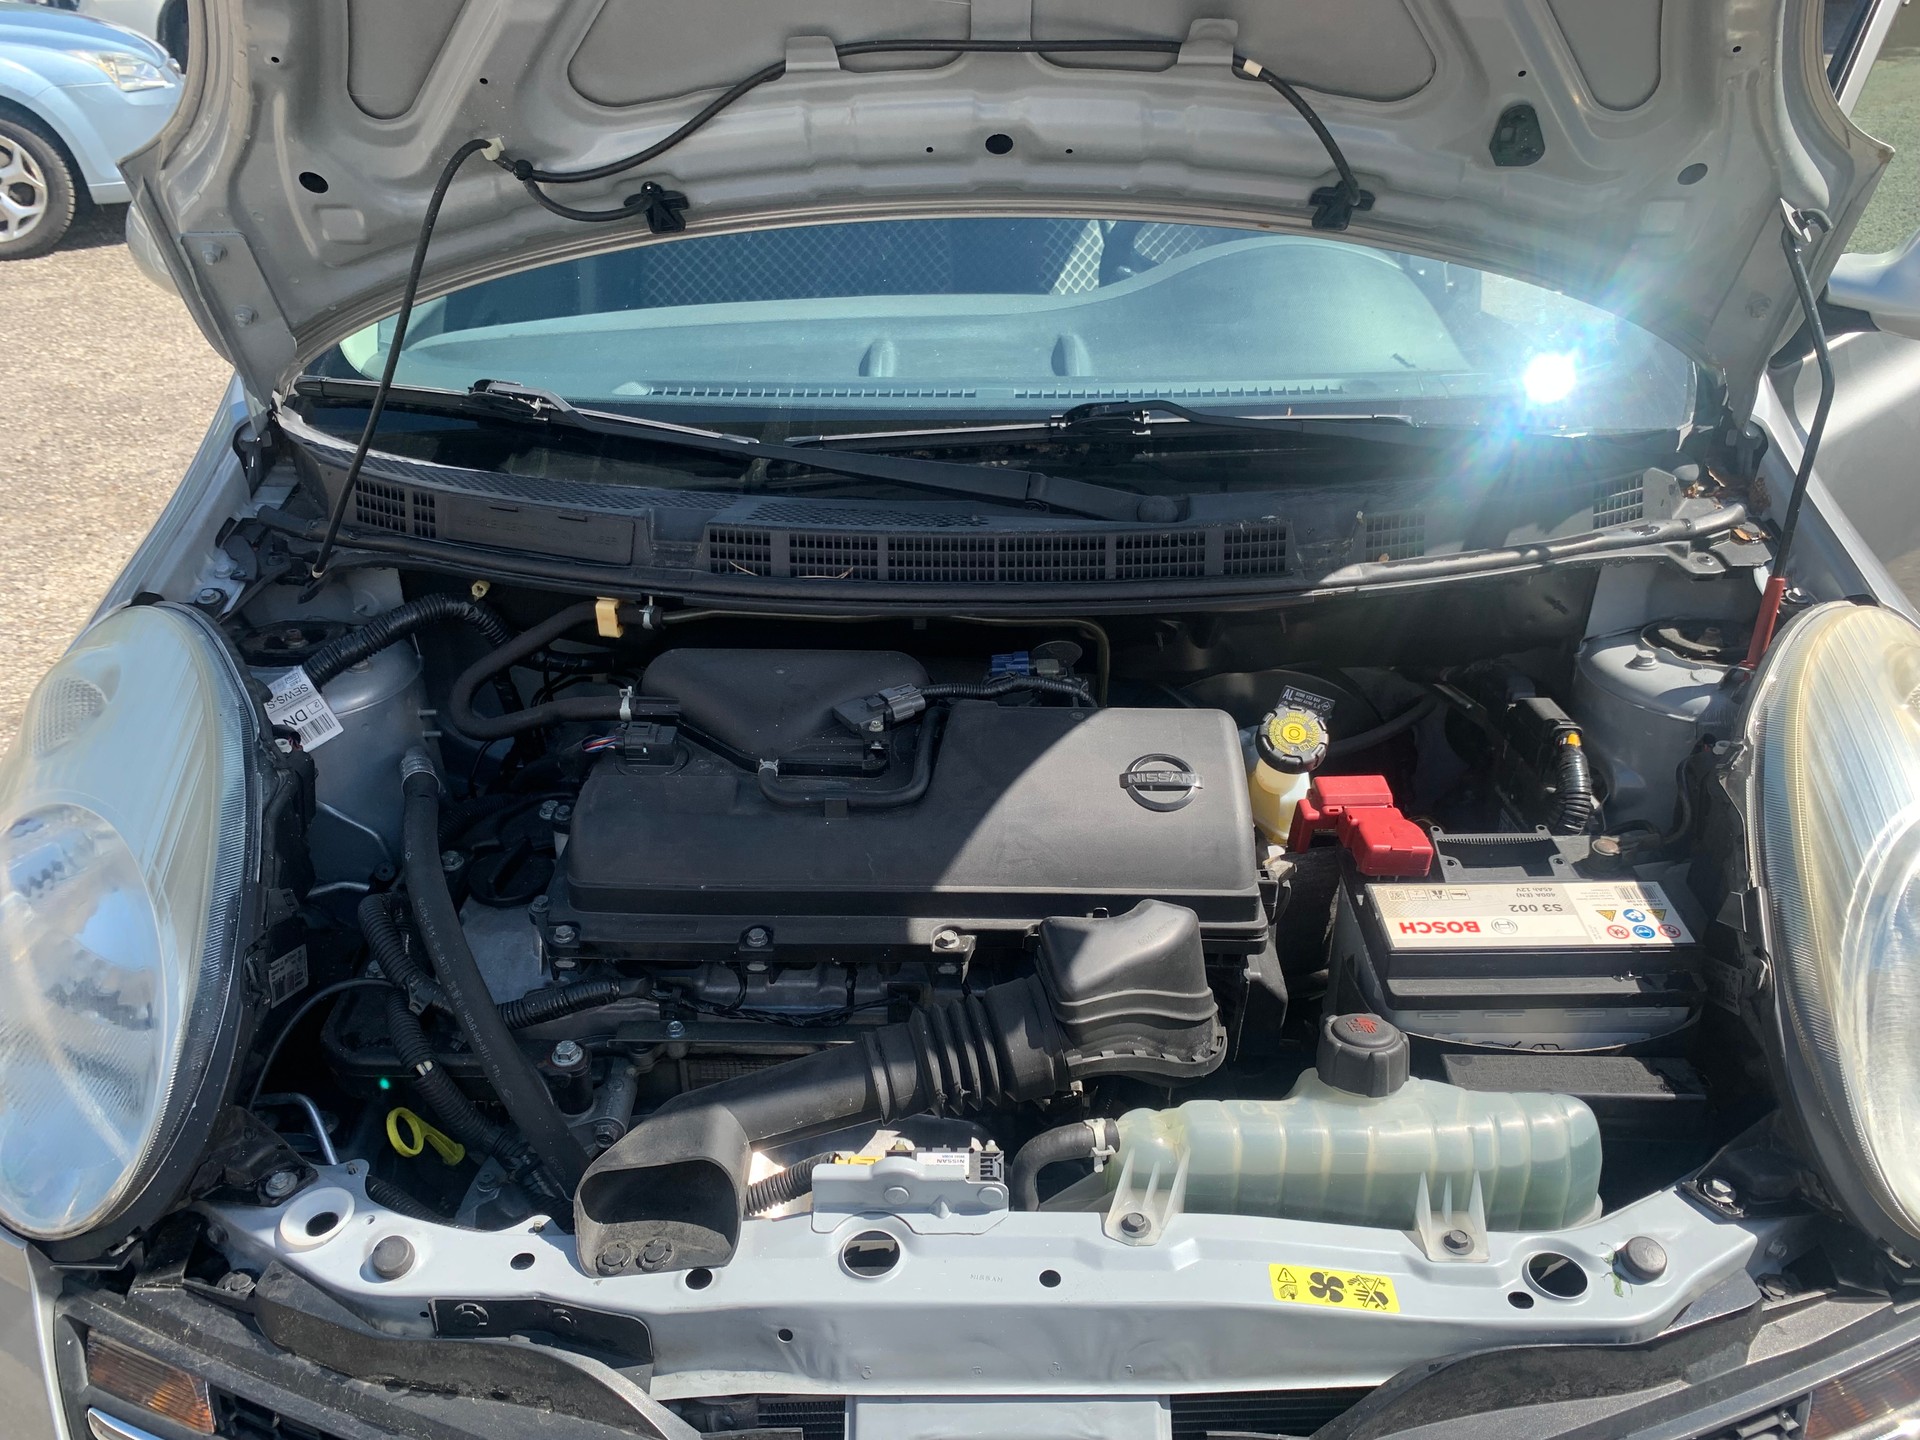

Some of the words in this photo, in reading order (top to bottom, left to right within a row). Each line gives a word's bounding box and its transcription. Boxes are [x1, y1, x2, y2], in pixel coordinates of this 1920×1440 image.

[1282, 689, 1293, 701] AL
[1127, 772, 1196, 784] NISSAN
[1508, 904, 1539, 913] 002
[1542, 903, 1563, 912] S3
[1399, 921, 1481, 934] BOSCH
